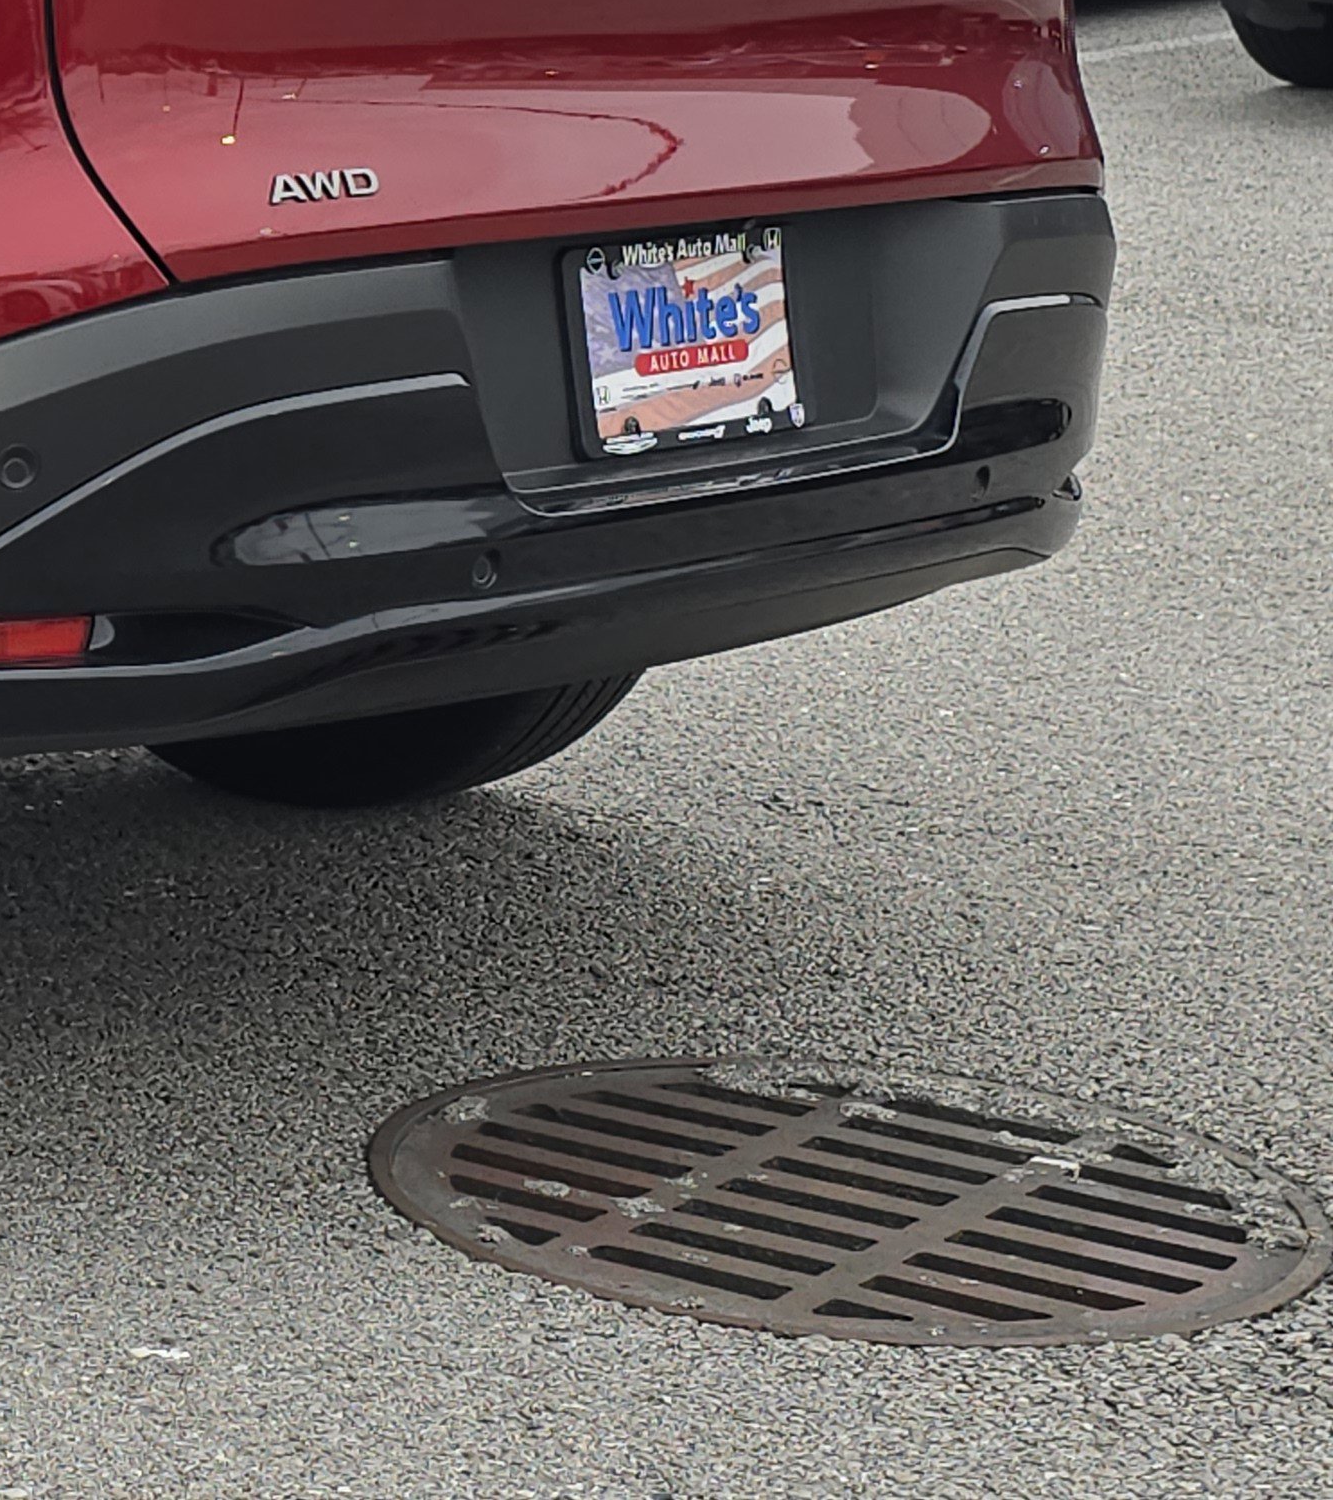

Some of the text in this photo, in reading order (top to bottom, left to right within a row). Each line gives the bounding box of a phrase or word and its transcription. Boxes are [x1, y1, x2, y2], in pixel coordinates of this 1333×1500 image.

[269, 167, 379, 206] AWD
[622, 233, 746, 266] White's Auto Mall
[608, 277, 761, 352] White's
[649, 346, 737, 372] AUTO MALL
